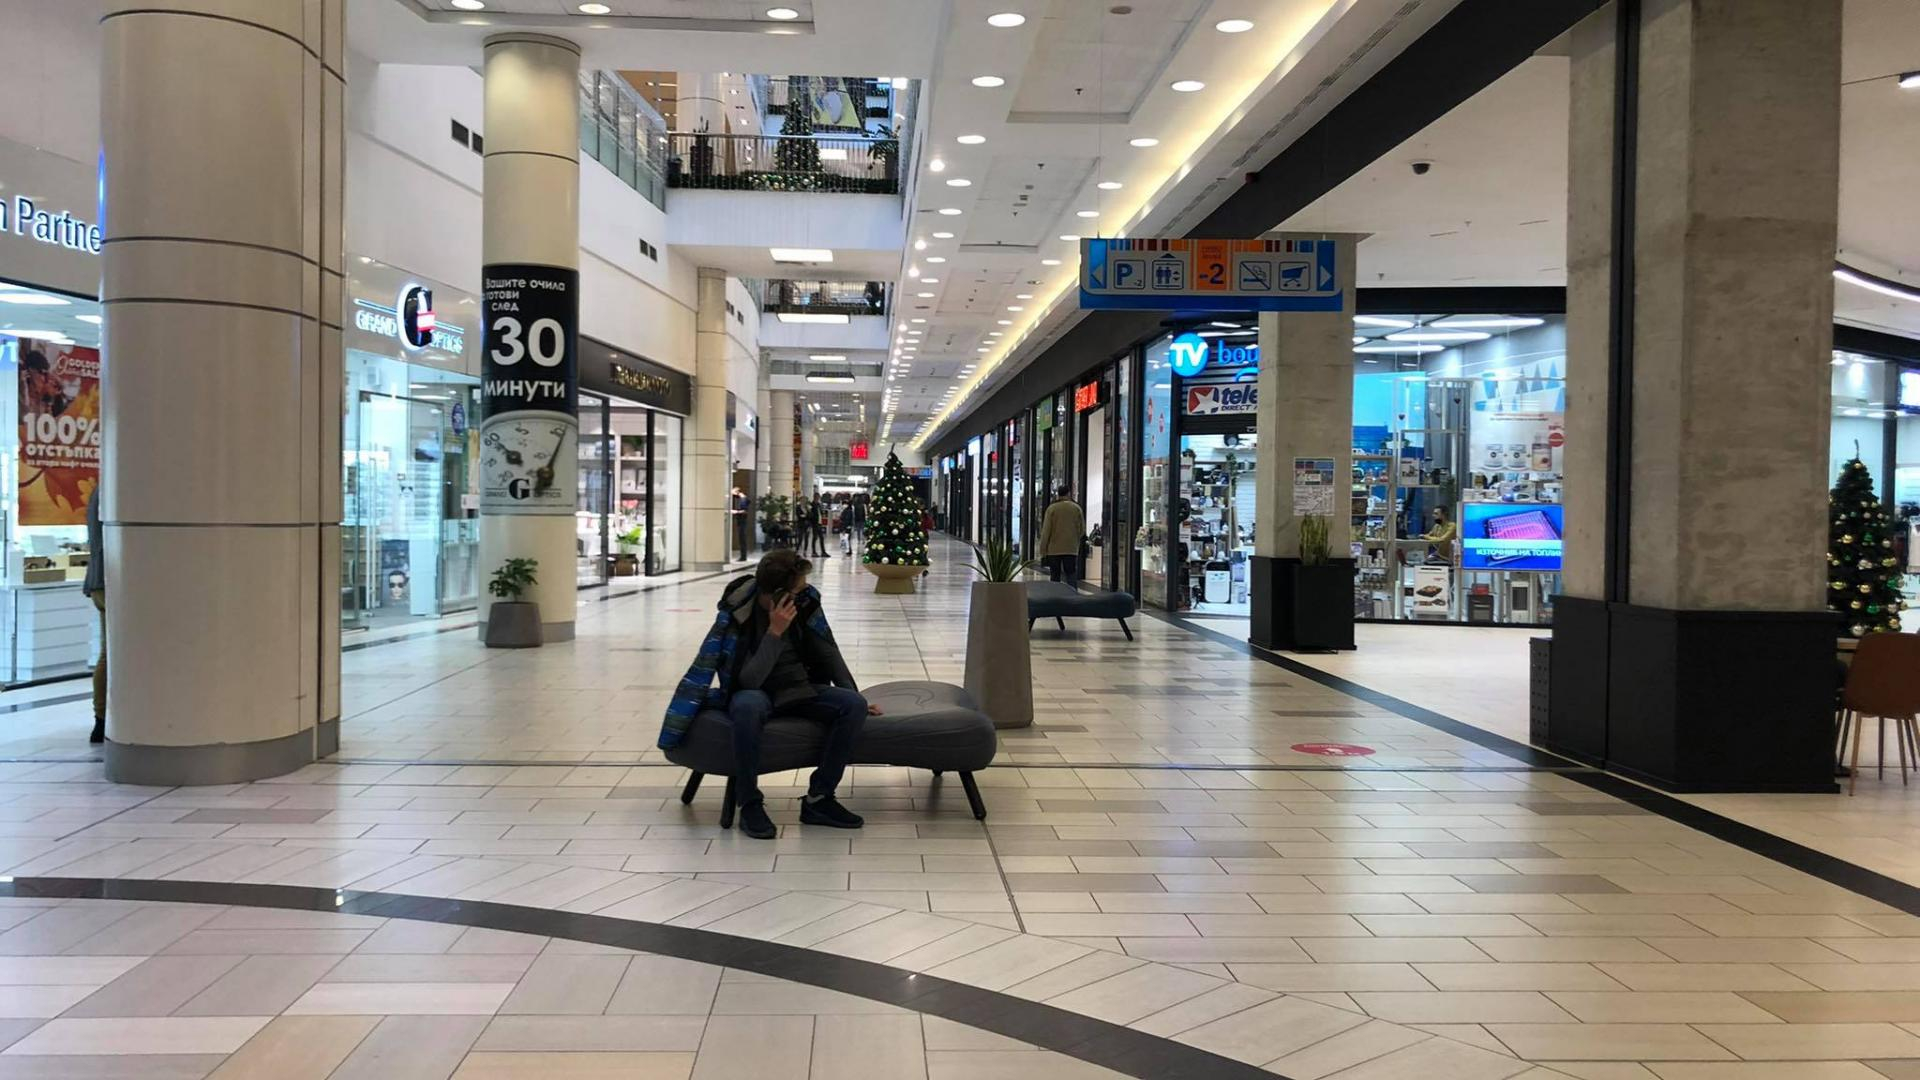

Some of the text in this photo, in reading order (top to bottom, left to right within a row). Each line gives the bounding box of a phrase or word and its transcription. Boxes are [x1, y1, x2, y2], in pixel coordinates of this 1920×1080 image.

[530, 279, 566, 291] очила
[1199, 263, 1225, 285] -2
[491, 302, 520, 312] след
[491, 316, 566, 367] 30
[1169, 341, 1208, 367] TV
[23, 412, 100, 445] 100%
[508, 478, 530, 500] G
